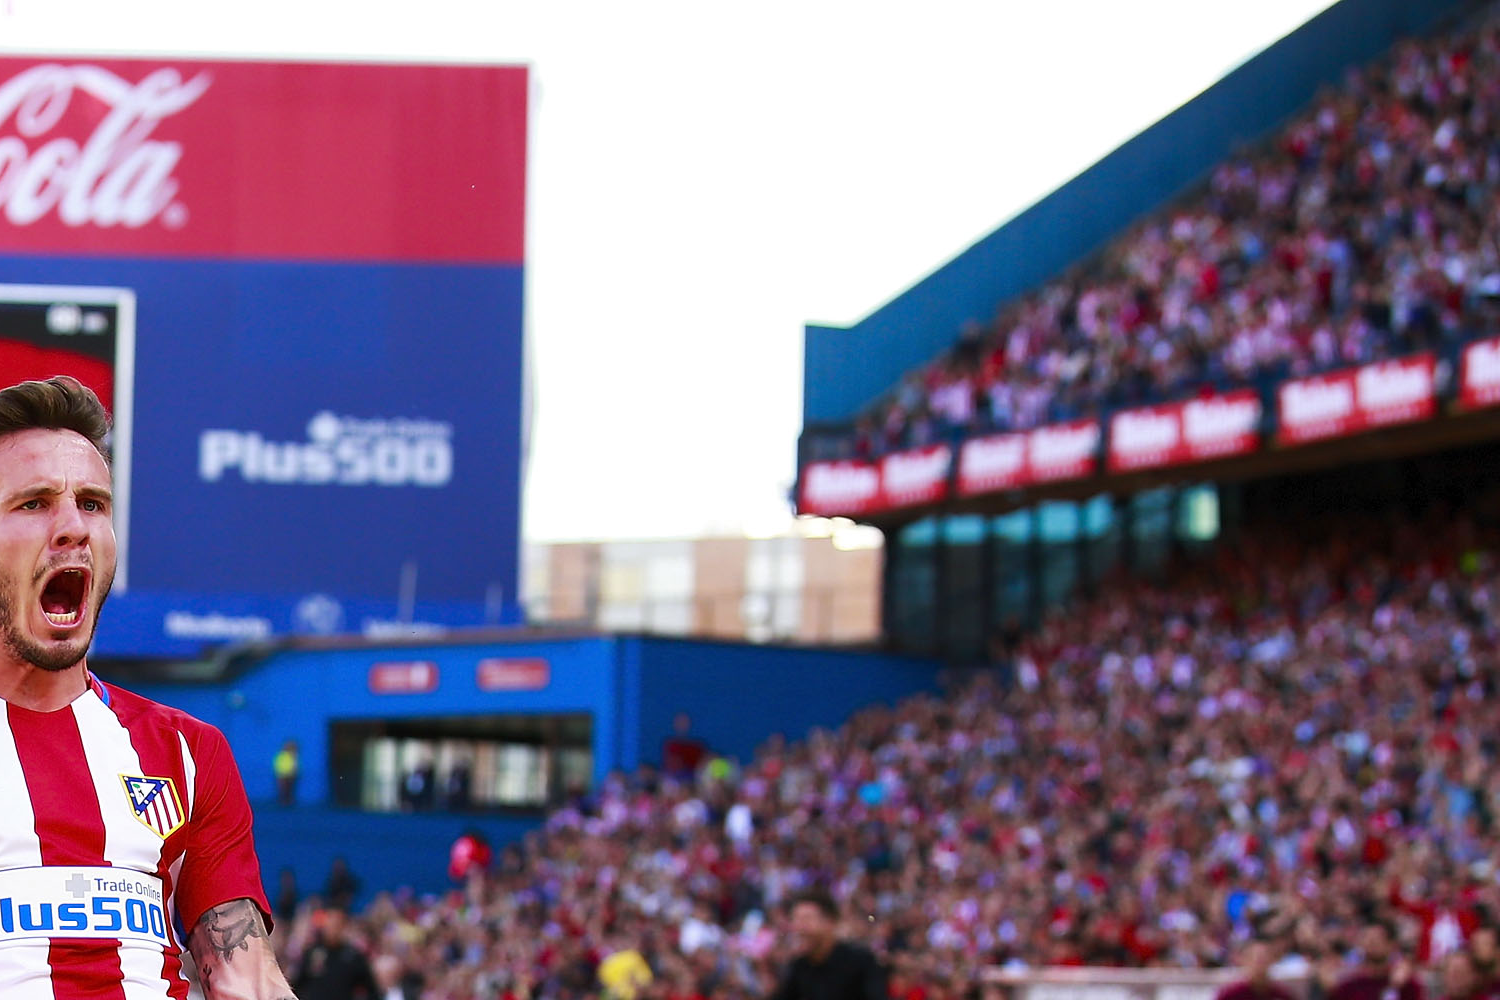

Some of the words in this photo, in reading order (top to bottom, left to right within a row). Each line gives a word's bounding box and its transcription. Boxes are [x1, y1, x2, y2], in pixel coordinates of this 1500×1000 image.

[200, 428, 452, 488] Plus500
[94, 878, 133, 893] Trade
[135, 882, 161, 902] Online
